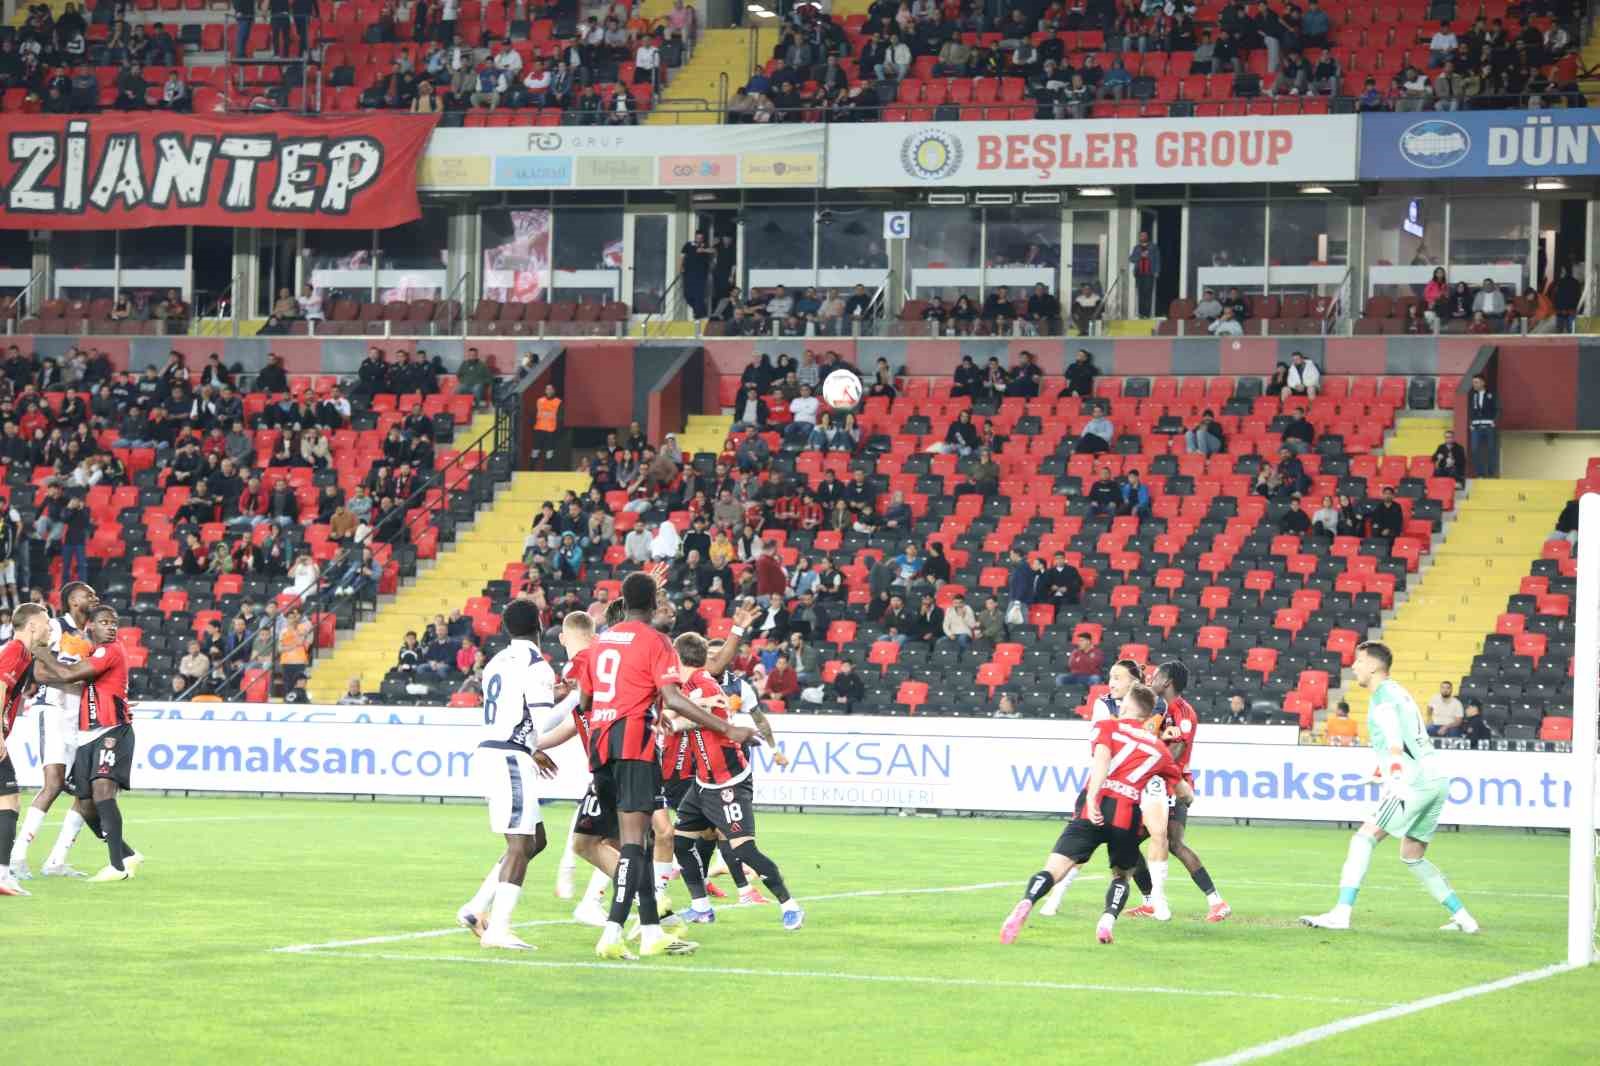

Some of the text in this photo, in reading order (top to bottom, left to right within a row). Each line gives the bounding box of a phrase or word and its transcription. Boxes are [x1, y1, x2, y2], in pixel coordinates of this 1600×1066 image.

[976, 129, 1294, 179] BEŞLER GROUP
[1487, 116, 1600, 166] DÜN
[889, 216, 905, 235] G
[593, 649, 621, 703] 9
[485, 673, 501, 725] 8
[25, 738, 475, 777] .ozmaksan.com
[99, 749, 116, 767] 14
[1108, 732, 1162, 783] 77
[582, 796, 601, 817] 10
[723, 803, 743, 823] 18
